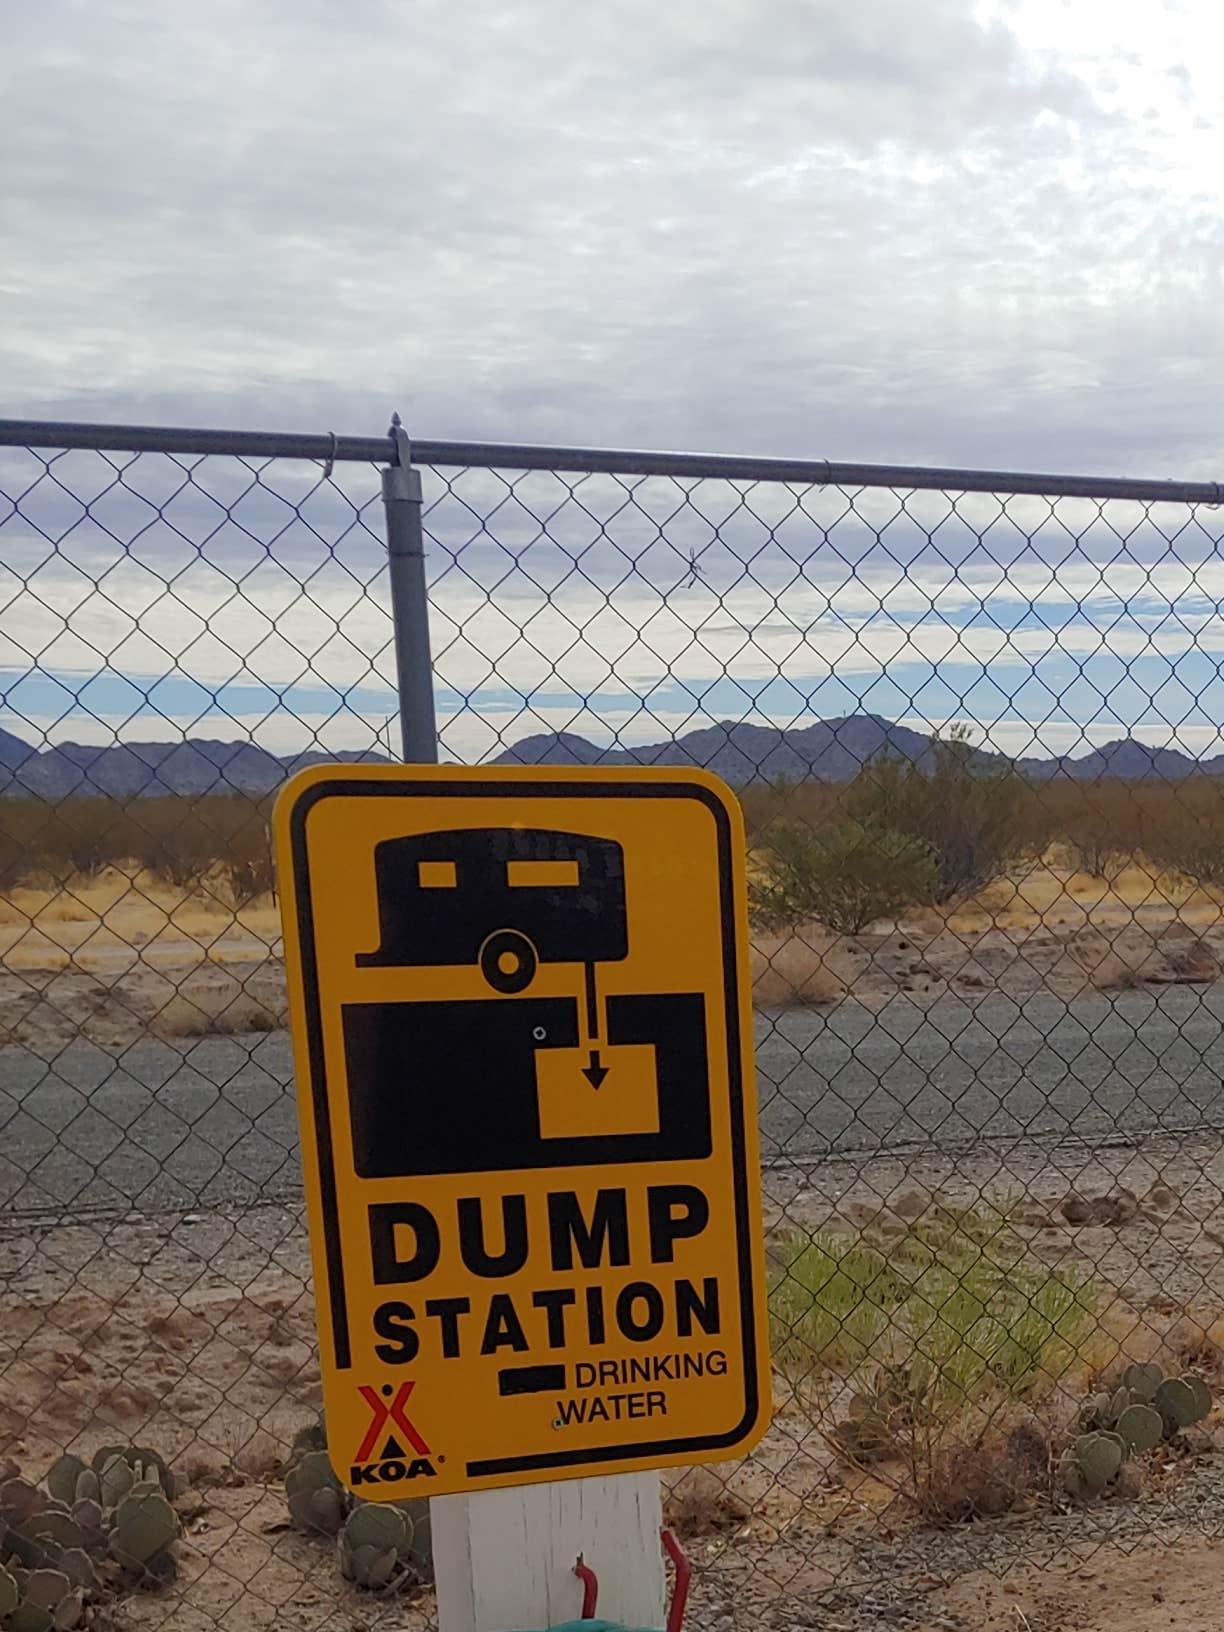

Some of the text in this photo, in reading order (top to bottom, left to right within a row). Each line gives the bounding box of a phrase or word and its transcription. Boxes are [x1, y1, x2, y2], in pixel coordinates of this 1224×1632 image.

[367, 1184, 710, 1286] DUMP
[372, 1277, 722, 1366] STATION
[575, 1350, 728, 1389] DRINKING
[556, 1391, 667, 1425] WATER
[350, 1459, 438, 1487] KOA
